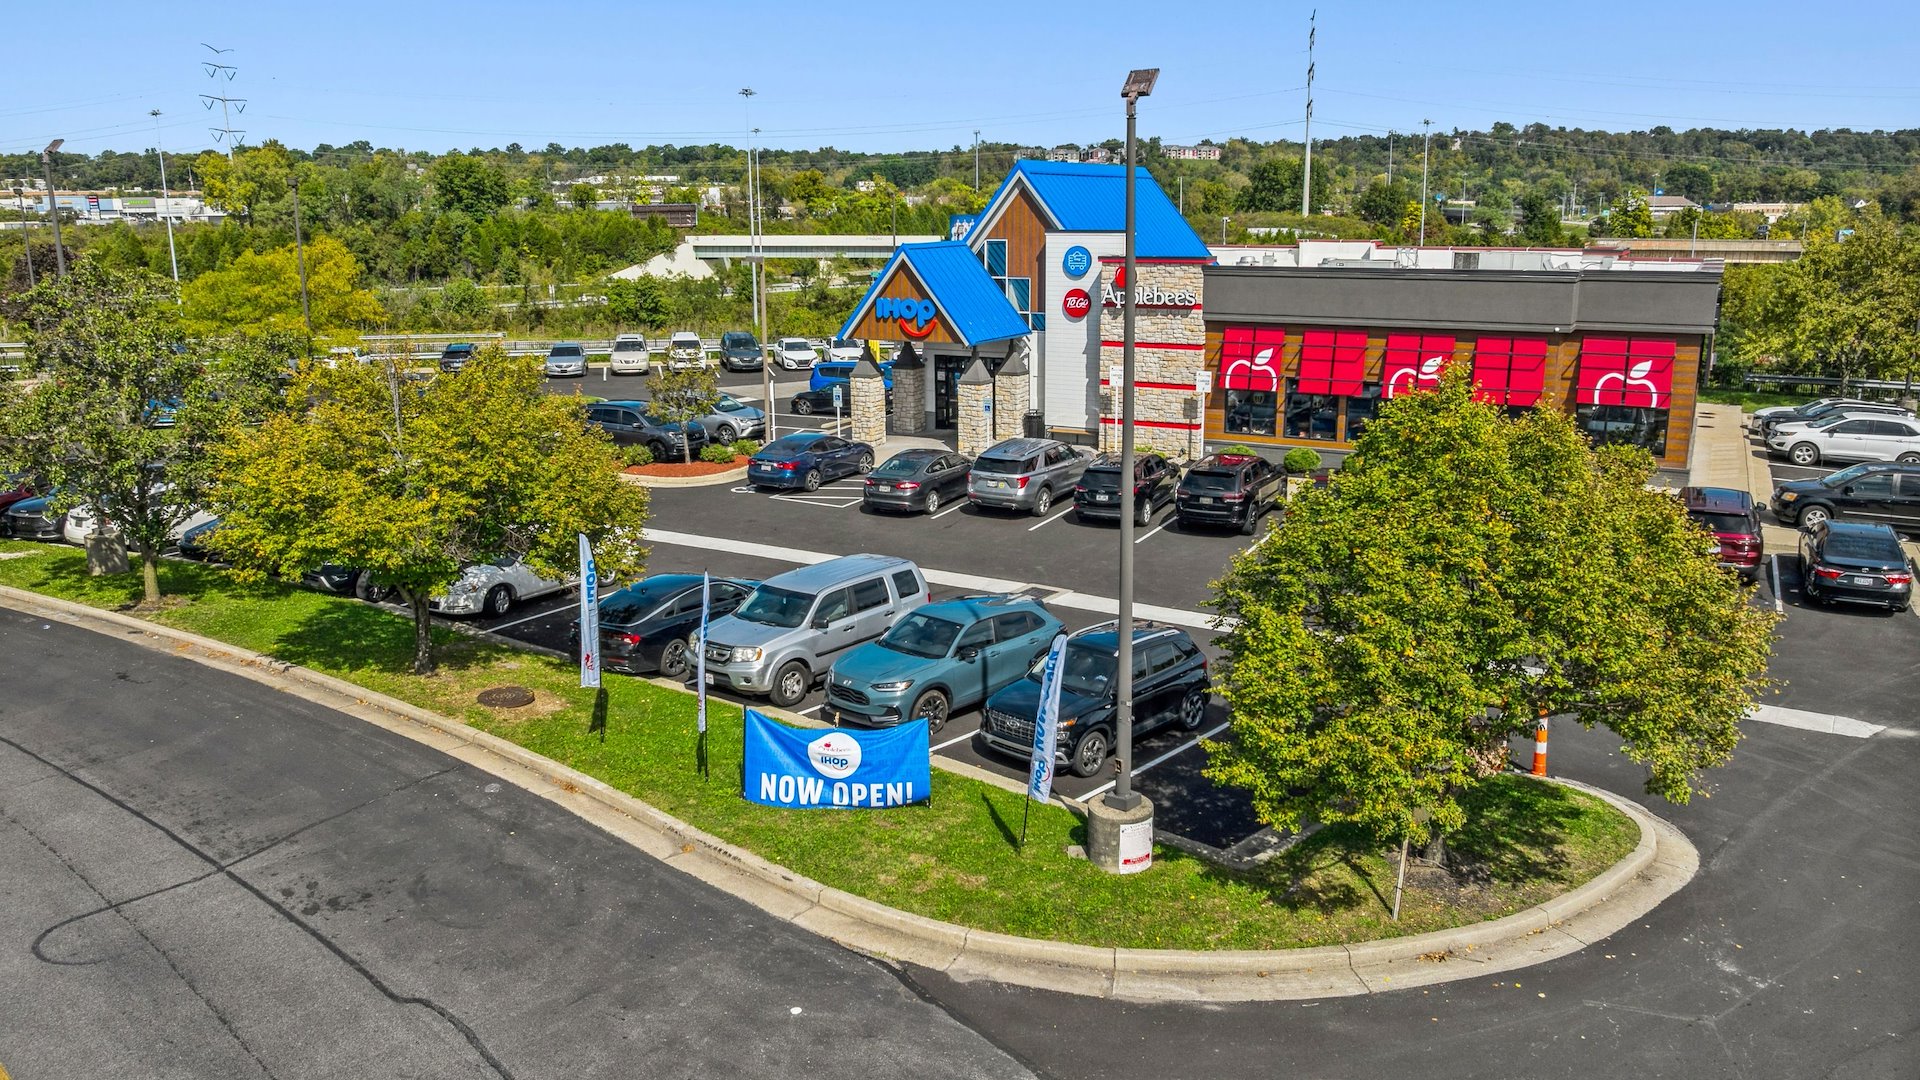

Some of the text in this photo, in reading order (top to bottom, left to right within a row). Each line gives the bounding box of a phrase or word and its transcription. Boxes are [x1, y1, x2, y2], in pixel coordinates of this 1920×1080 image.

[876, 297, 936, 328] IHOP
[821, 756, 848, 768] IHOP
[760, 772, 913, 808] NOW OPEN!
